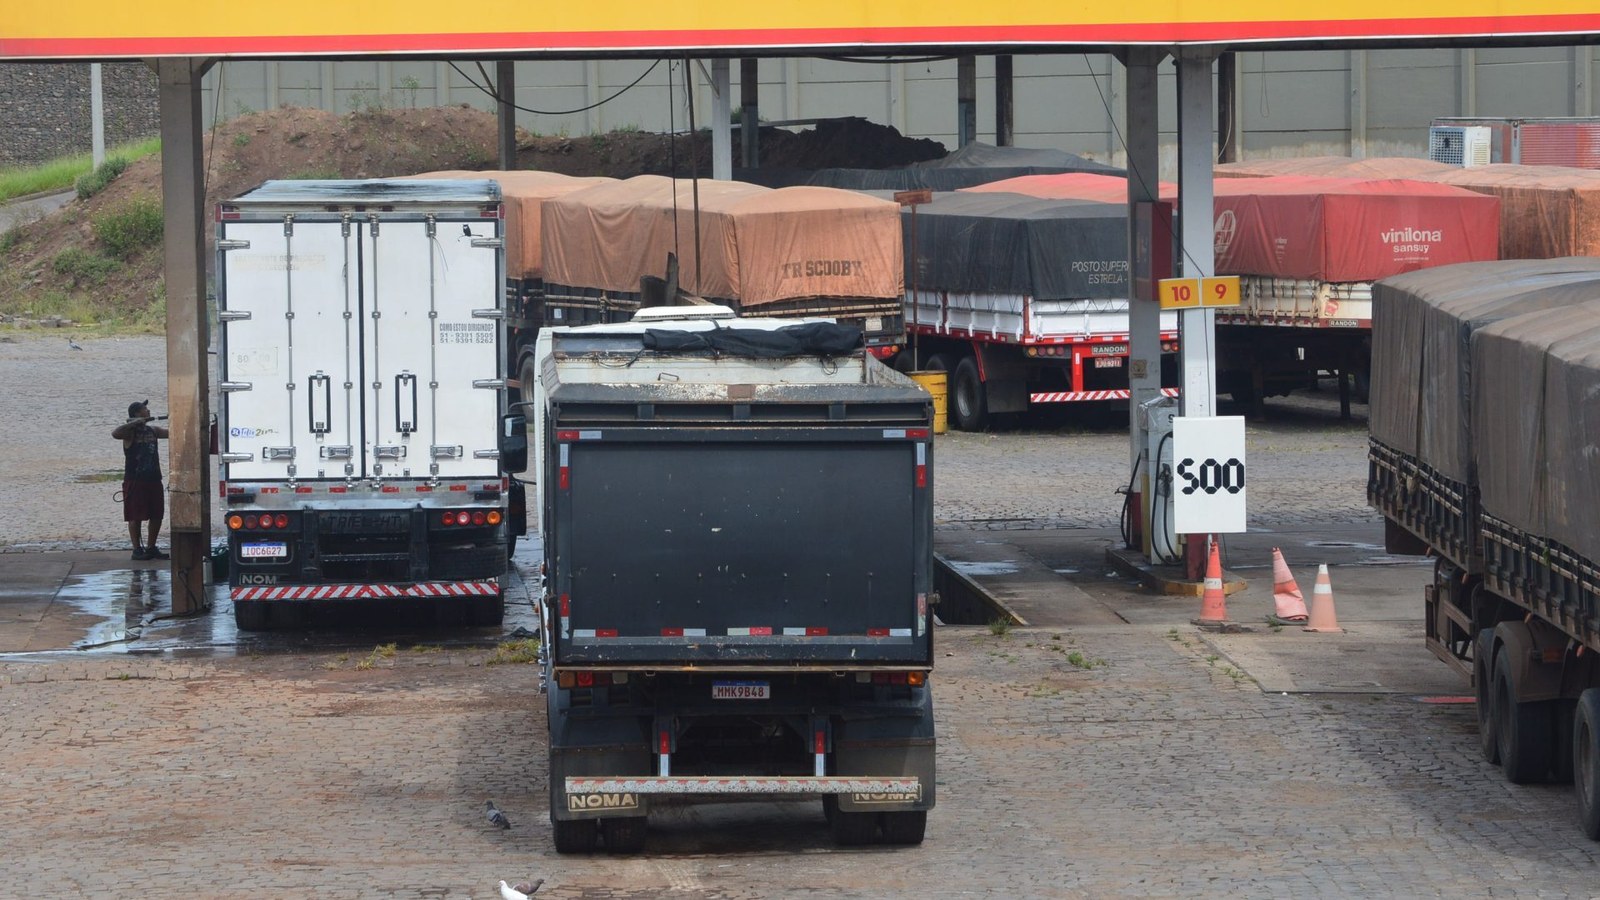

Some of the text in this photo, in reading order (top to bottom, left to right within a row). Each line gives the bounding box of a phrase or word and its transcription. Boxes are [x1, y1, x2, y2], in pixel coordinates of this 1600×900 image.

[1381, 227, 1442, 243] vinilona
[1393, 244, 1430, 254] sansuy
[781, 260, 862, 279] TR SCOOBY
[1071, 260, 1129, 272] POSTO SUPER
[1088, 274, 1123, 284] ESTRELA
[1171, 285, 1191, 302] 10
[1214, 283, 1227, 300] 9
[242, 575, 276, 585] NOM
[717, 686, 764, 697] MMK9B48
[570, 793, 635, 808] NOMA
